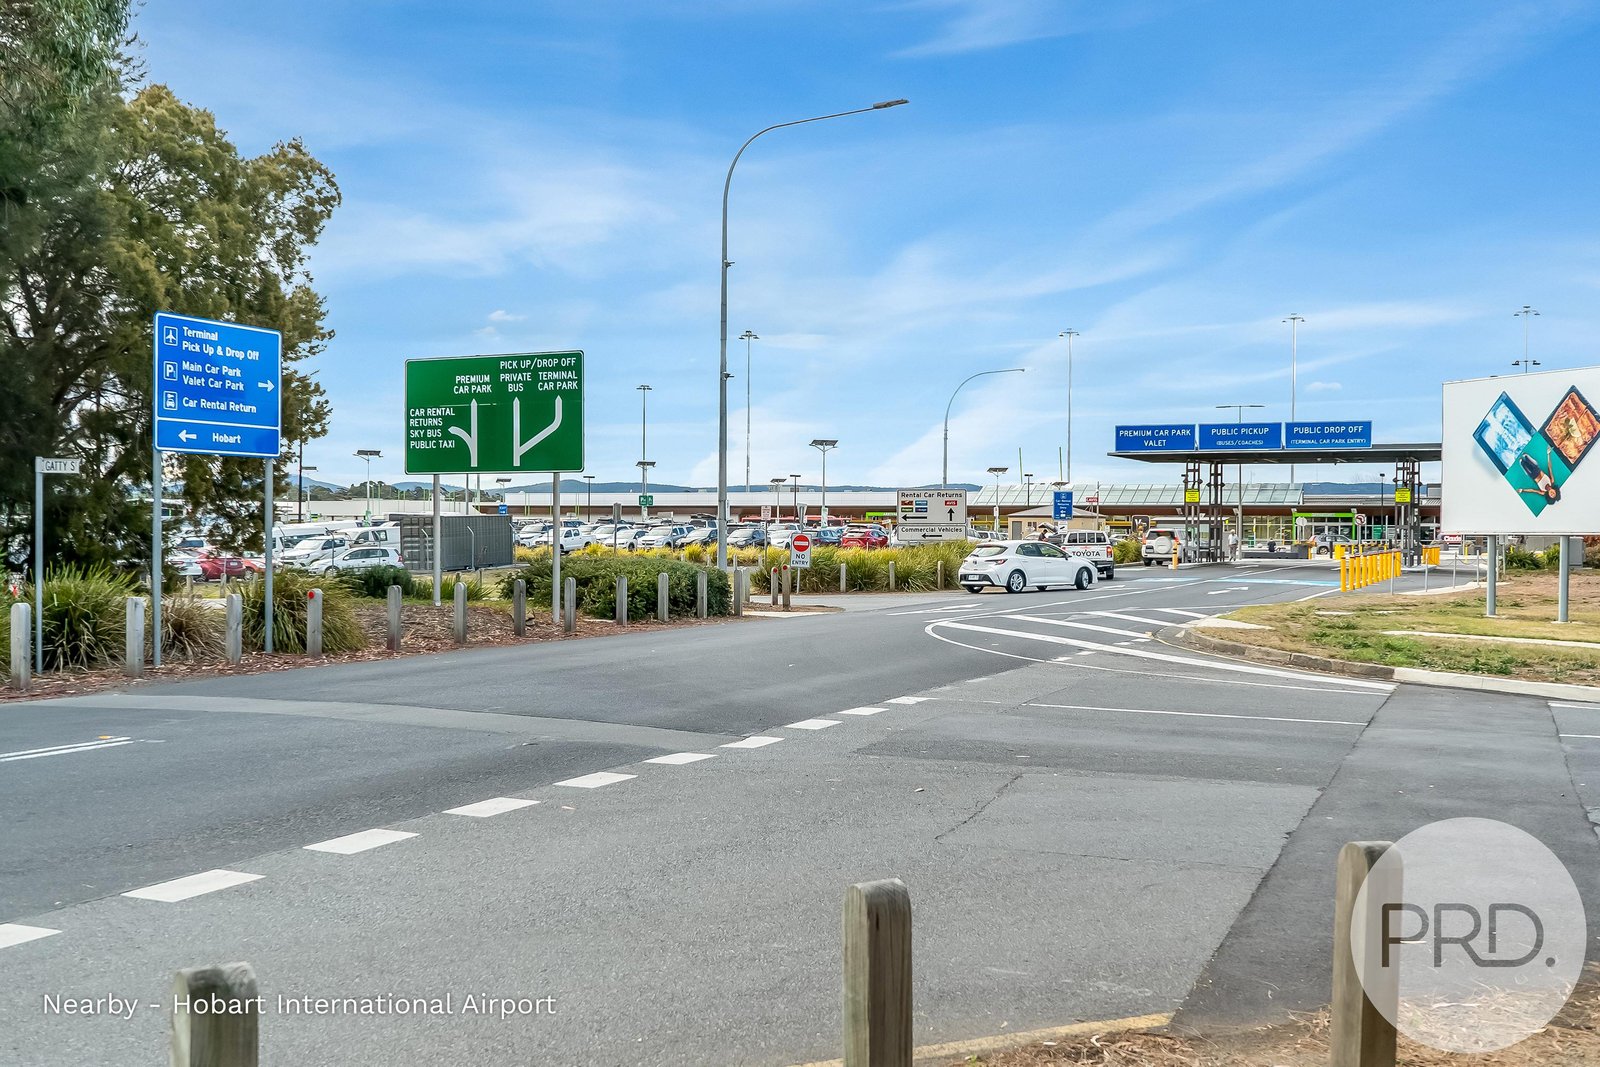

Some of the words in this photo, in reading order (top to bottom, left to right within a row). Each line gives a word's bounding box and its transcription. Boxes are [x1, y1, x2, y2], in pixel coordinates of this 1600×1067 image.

[182, 326, 218, 341] Terminal
[182, 341, 200, 353] Pick
[203, 344, 214, 356] Up
[216, 346, 223, 356] &
[226, 348, 245, 361] Drop
[247, 349, 260, 361] Off
[499, 360, 518, 370] PICK
[520, 357, 558, 370] UP/DROP
[560, 357, 577, 367] OFF
[182, 361, 202, 373] Main
[205, 363, 219, 375] Car
[222, 366, 241, 377] Park
[455, 374, 491, 384] PREMIUM
[499, 372, 532, 382] PRIVATE
[538, 370, 578, 381] TERMINAL
[183, 375, 205, 387] Valet
[208, 378, 222, 389] Car
[225, 380, 244, 391] Park
[507, 383, 524, 392] BUS
[537, 382, 555, 391] CAR
[556, 381, 578, 390] PARK
[453, 385, 470, 395] CAR
[471, 384, 493, 394] PARK
[182, 397, 198, 408] Car
[200, 398, 227, 411] Rental
[229, 401, 257, 414] Return
[409, 408, 426, 417] CAR
[426, 407, 456, 417] RENTAL
[409, 417, 443, 427] RETURNS
[409, 429, 425, 438] SKY
[426, 428, 442, 438] BUS
[1119, 429, 1152, 437] PREMIUM
[1154, 429, 1170, 437] CAR
[1171, 428, 1191, 436] PARK
[1211, 428, 1238, 436] PUBLIC
[1240, 427, 1270, 435] PICKUP
[1293, 426, 1322, 434] PUBLIC
[1324, 425, 1346, 434] DROP
[1348, 425, 1364, 433] OFF
[212, 432, 241, 444] Hobart
[1143, 439, 1167, 447] VALET
[410, 440, 437, 449] PUBLIC
[438, 439, 455, 449] TAXI
[45, 461, 68, 471] GATTY
